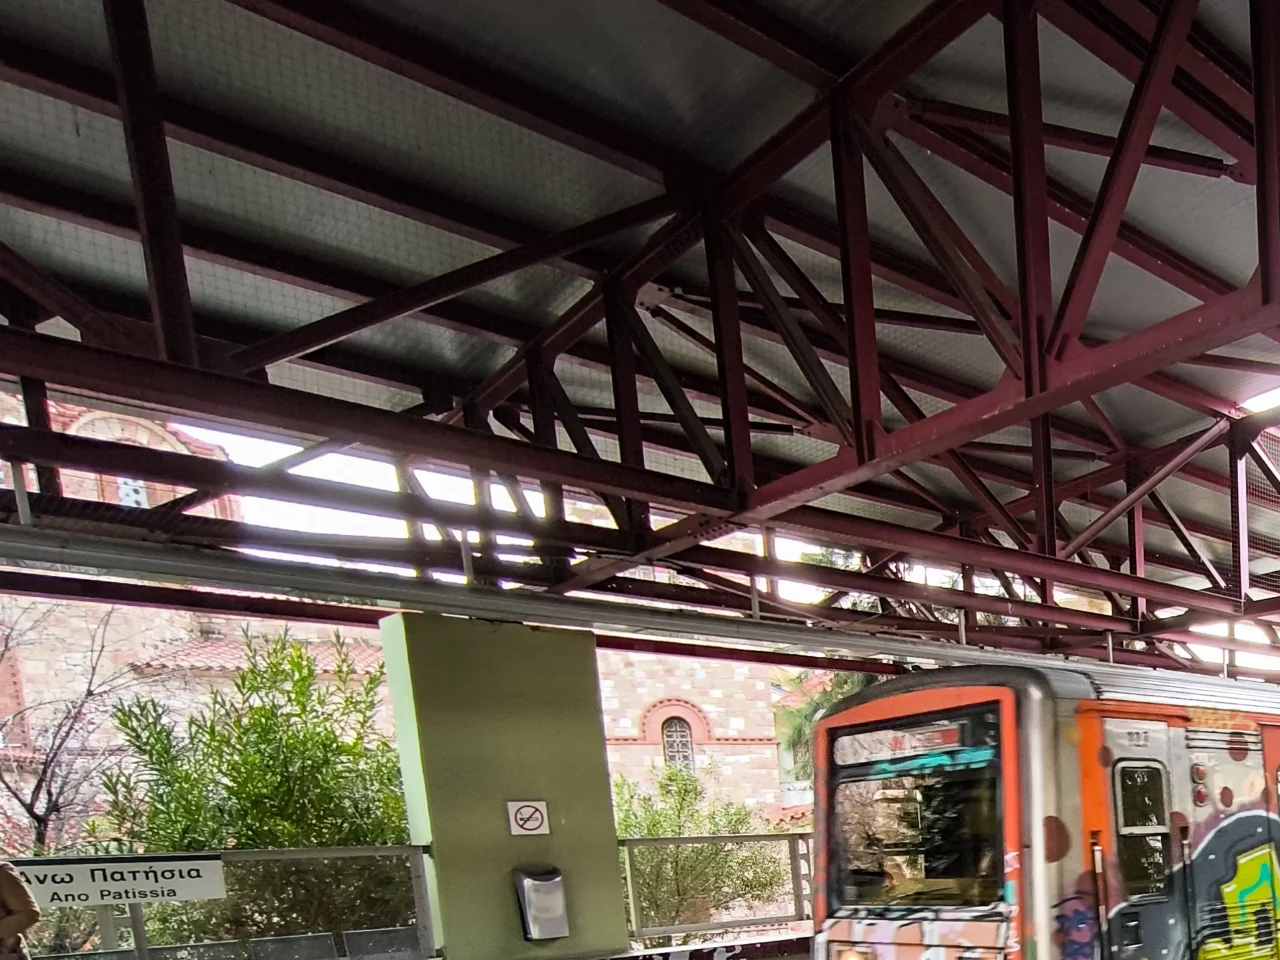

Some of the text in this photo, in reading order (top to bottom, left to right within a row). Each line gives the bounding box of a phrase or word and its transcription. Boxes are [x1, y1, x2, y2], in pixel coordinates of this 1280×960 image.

[90, 866, 203, 884] Πατήσια
[50, 887, 177, 903] Ano Patissia
